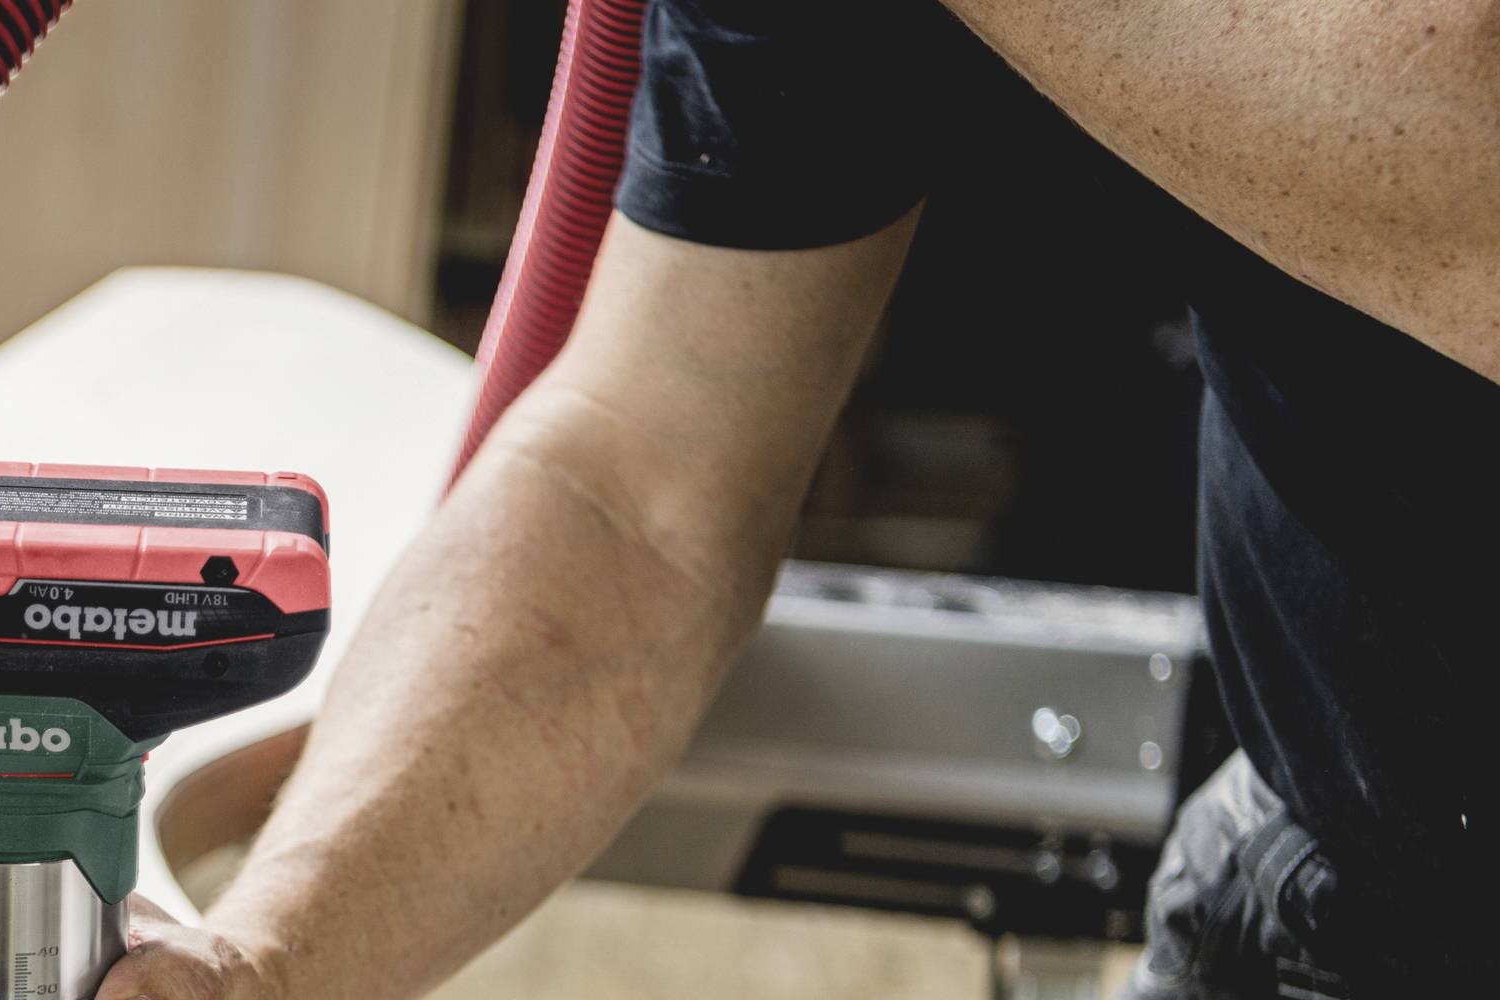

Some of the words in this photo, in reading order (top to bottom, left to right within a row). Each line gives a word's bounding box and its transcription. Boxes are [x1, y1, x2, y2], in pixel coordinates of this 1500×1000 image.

[165, 591, 199, 605] LiHD
[202, 592, 229, 606] 18V
[24, 603, 197, 640] metabo
[38, 946, 59, 957] 40
[37, 984, 58, 995] 30
